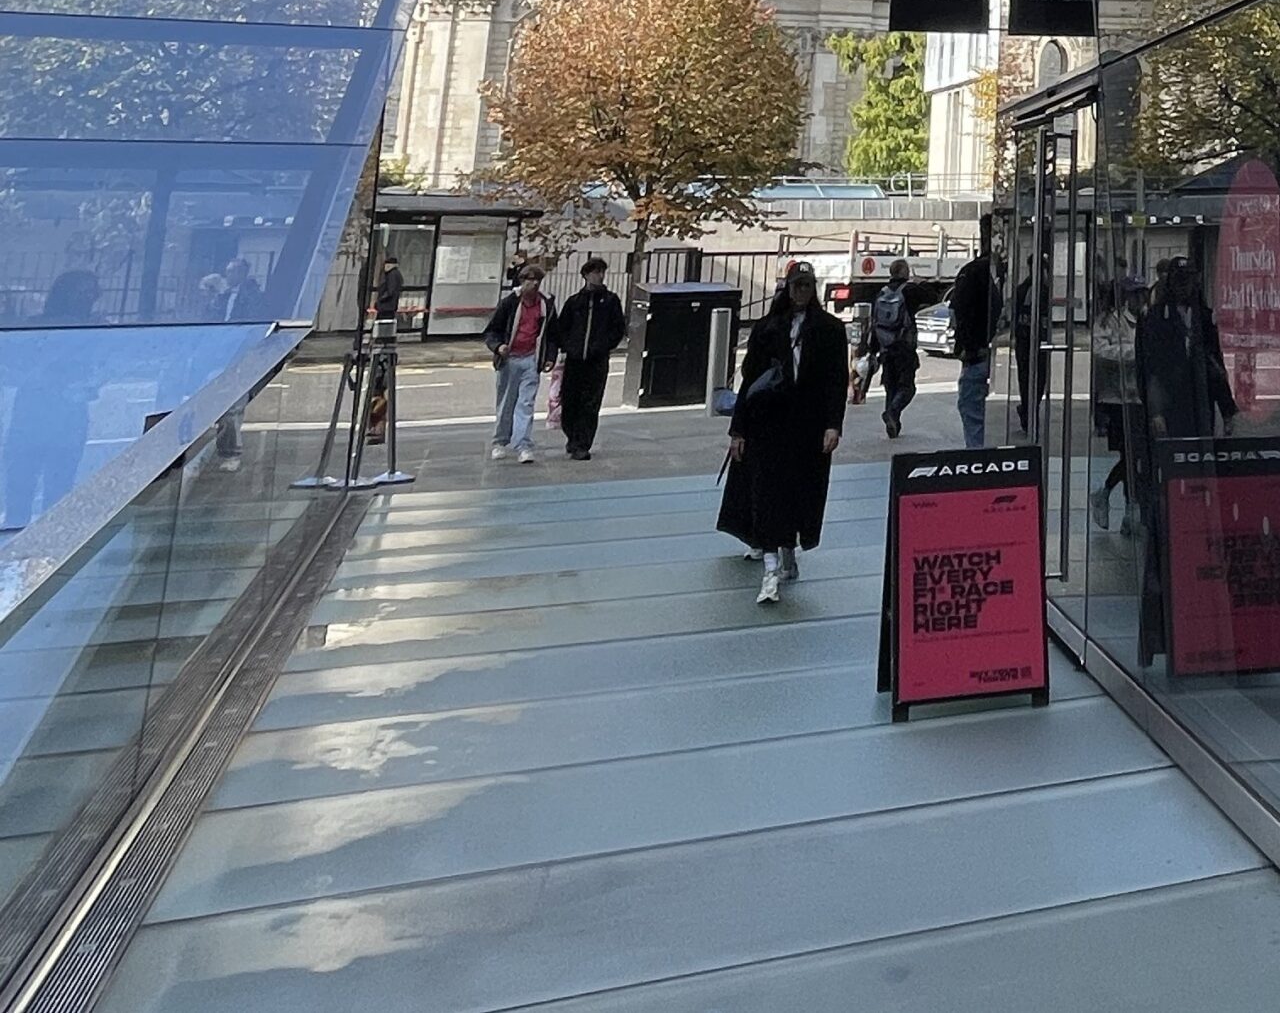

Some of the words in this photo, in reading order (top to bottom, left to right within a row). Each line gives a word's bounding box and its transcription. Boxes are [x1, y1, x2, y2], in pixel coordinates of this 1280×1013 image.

[1229, 244, 1276, 279] Thursday
[939, 460, 1029, 476] ARCADE
[913, 550, 1001, 571] WATCH
[913, 566, 994, 589] EVERY
[950, 580, 1014, 600] RACE
[913, 597, 987, 618] RIGHT
[913, 614, 977, 634] HERE
